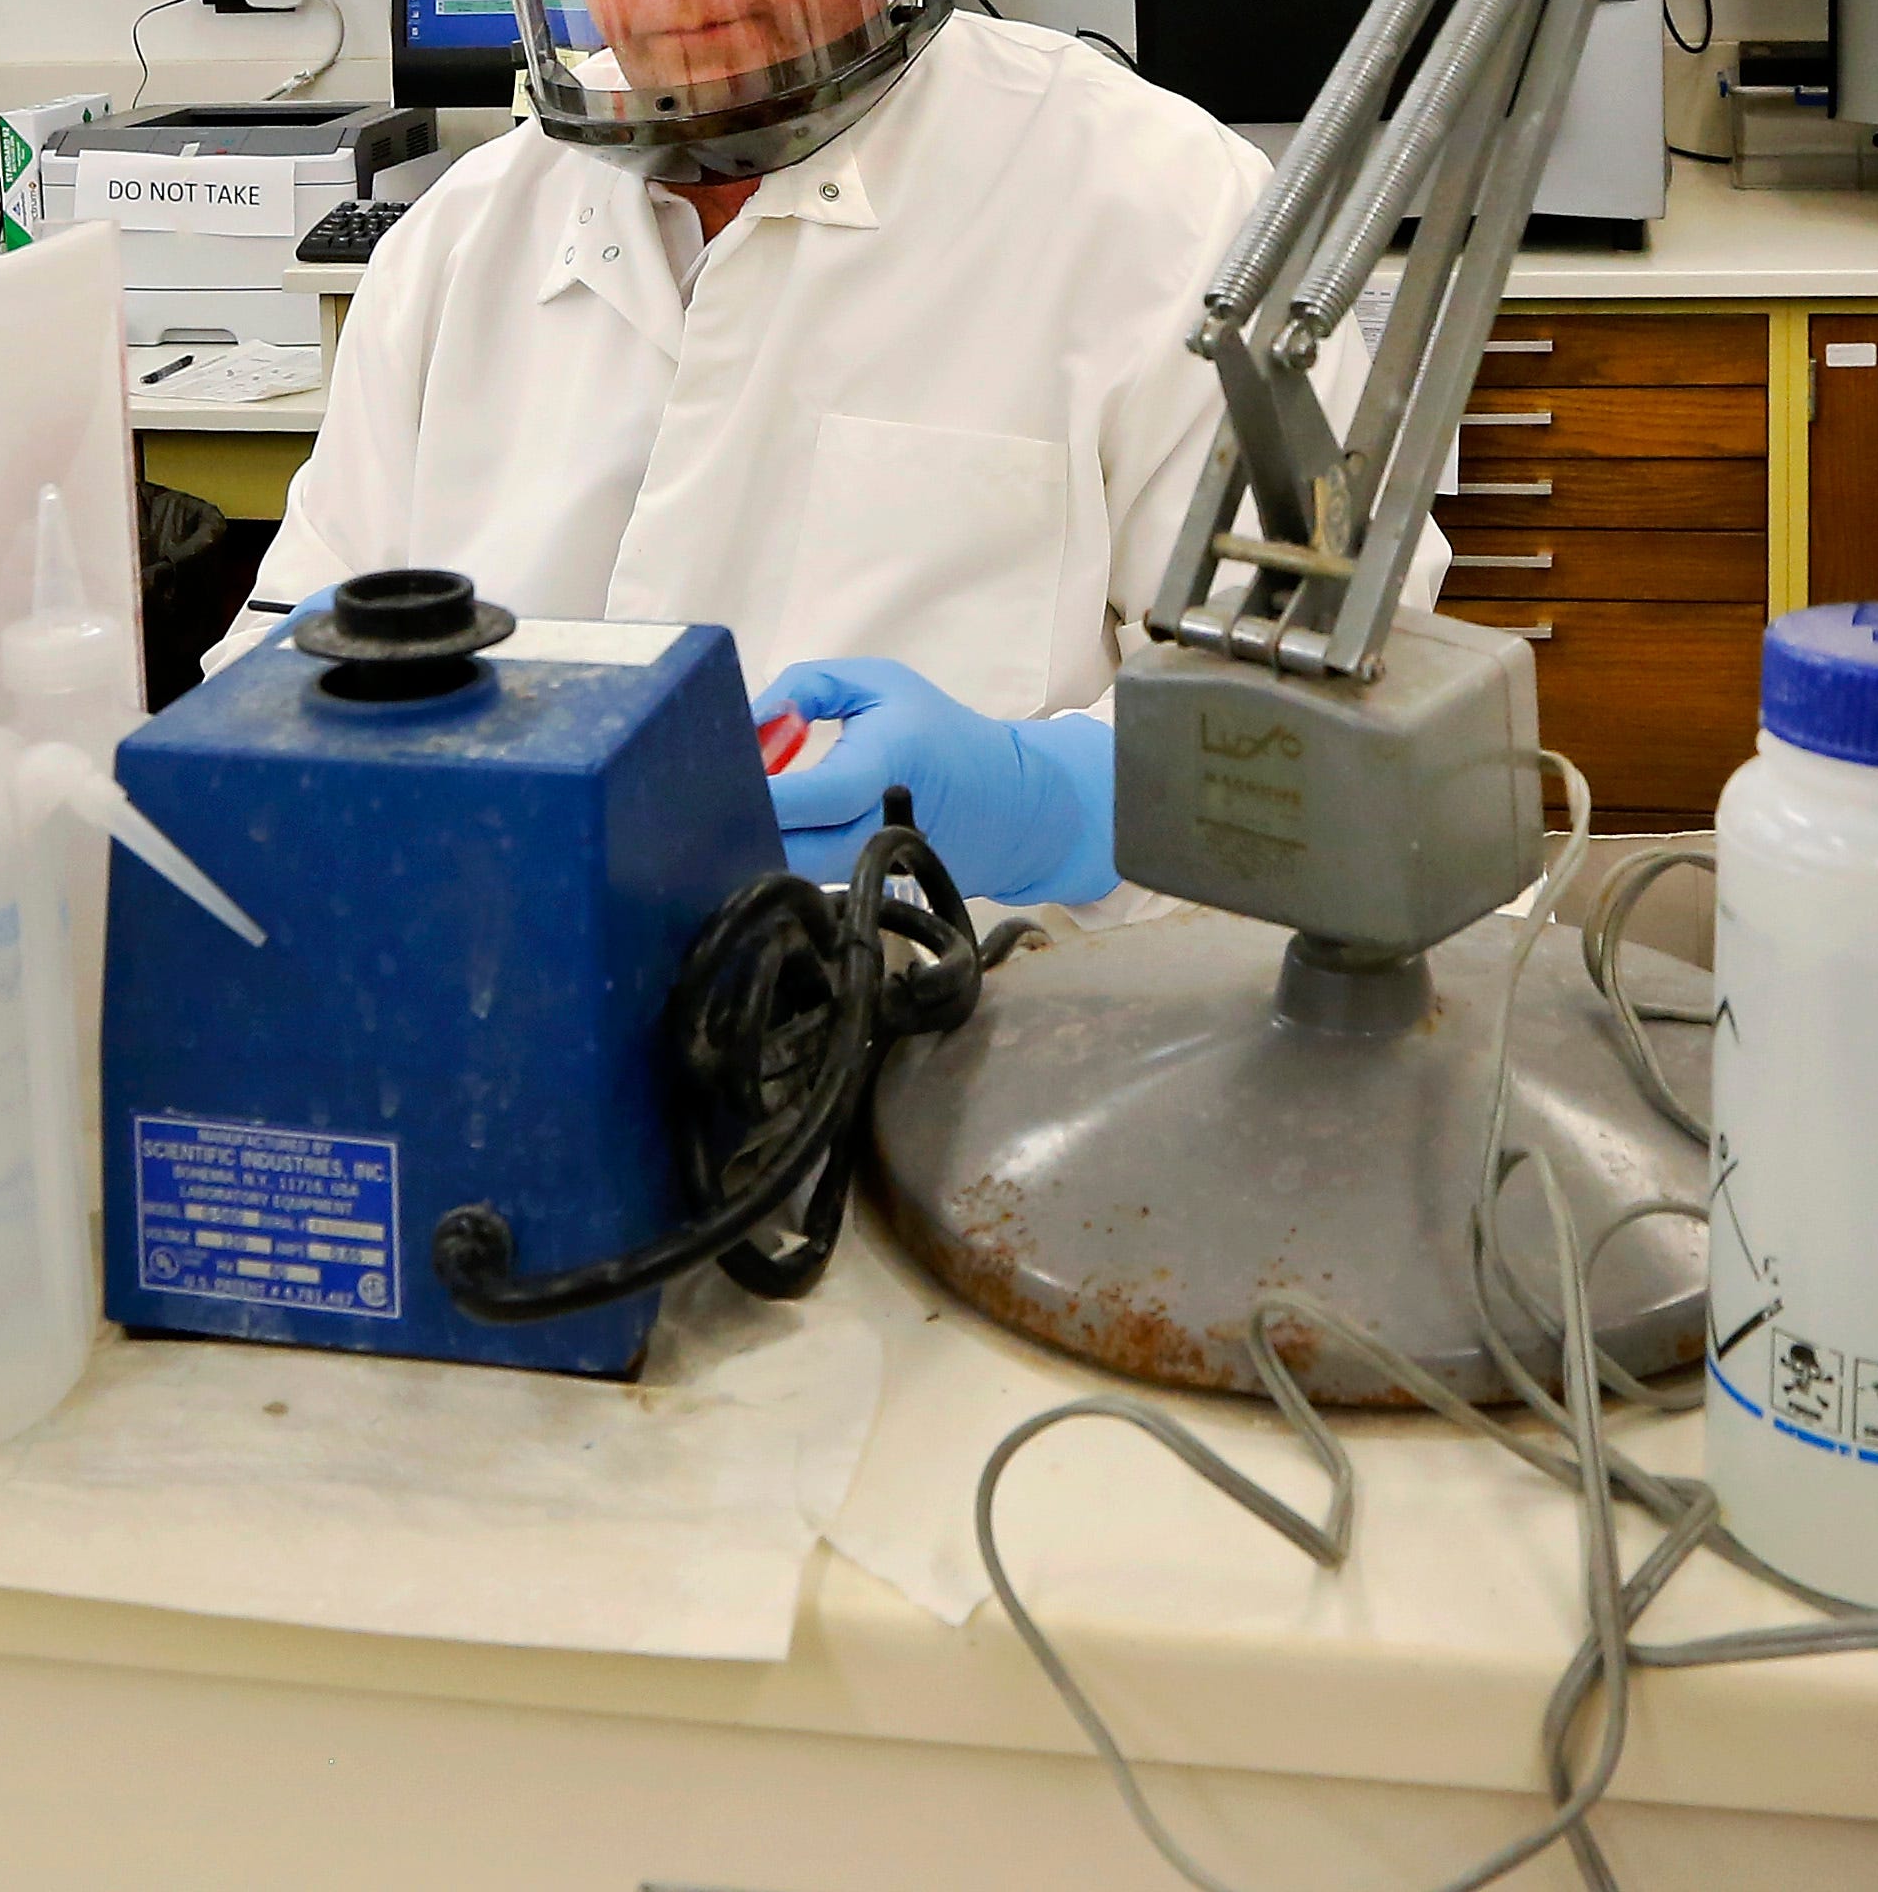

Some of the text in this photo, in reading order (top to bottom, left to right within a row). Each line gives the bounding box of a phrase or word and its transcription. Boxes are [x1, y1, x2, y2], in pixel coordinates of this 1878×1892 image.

[109, 180, 260, 205] DO NOT TAKE
[142, 1139, 237, 1166] SCIENTIFIC
[272, 1194, 352, 1215] EQUIPMENT
